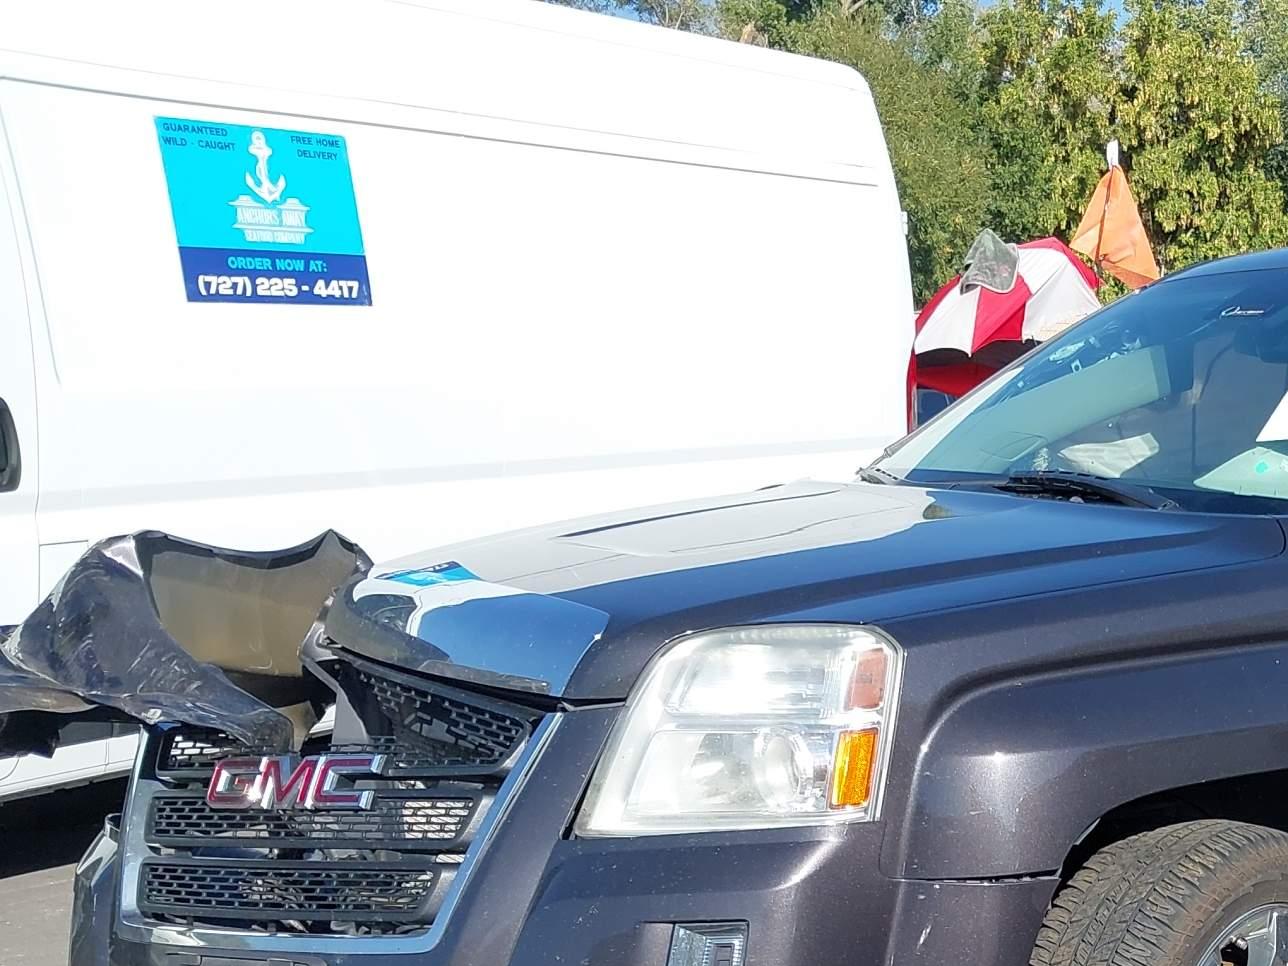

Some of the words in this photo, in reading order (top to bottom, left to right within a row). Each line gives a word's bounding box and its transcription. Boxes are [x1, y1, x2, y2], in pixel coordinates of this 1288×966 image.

[162, 123, 228, 137] GUARANTEED
[161, 136, 188, 147] WILD
[198, 140, 236, 151] CAUGHT
[290, 136, 313, 146] FREE
[316, 137, 341, 149] HOME
[297, 149, 338, 161] DELIVERY
[228, 256, 273, 271] ORDER
[275, 259, 305, 272] NOW
[309, 260, 328, 273] AT:
[198, 274, 252, 297] (727)
[256, 277, 298, 297] 225
[313, 279, 360, 299] 4417
[206, 754, 388, 810] GMC
